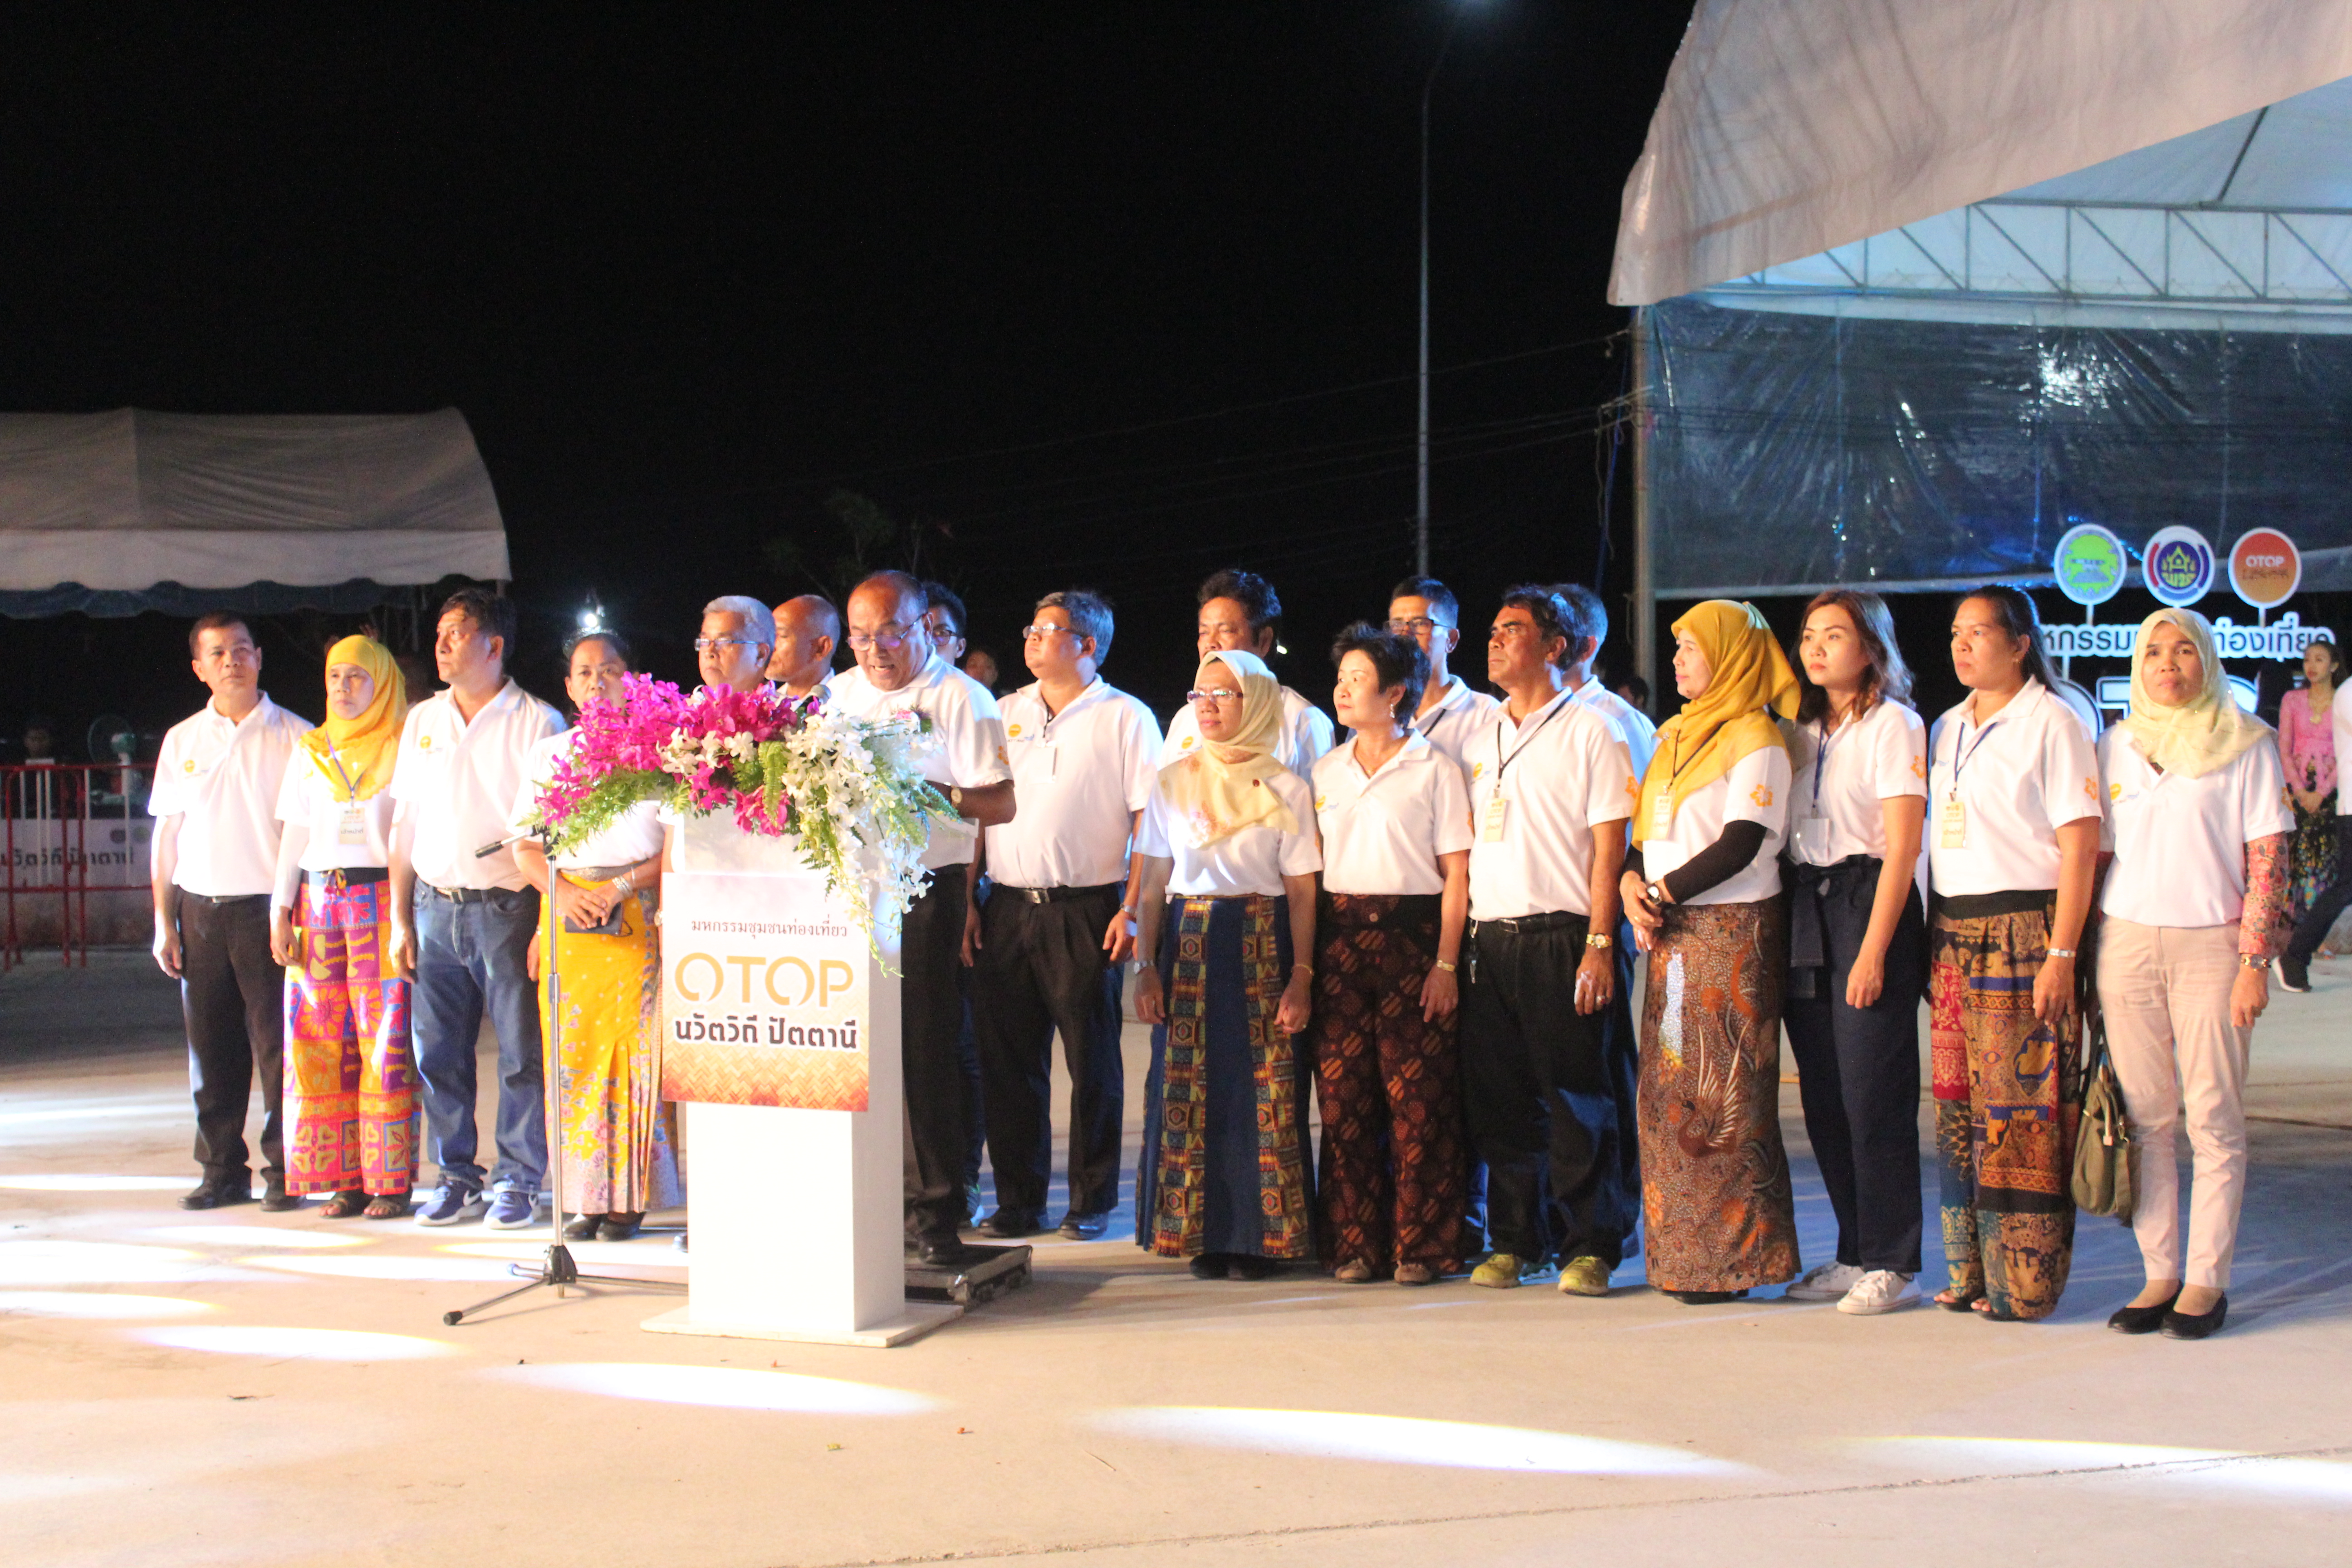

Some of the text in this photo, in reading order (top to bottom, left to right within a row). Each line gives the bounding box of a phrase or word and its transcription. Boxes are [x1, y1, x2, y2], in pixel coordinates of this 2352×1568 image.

[2245, 554, 2285, 568] OTOP
[691, 914, 848, 940] มหกรรมชุมชนท่องเที่ยว
[675, 952, 853, 1007] OTOP
[675, 1013, 857, 1049] นวัตวิถี ปัตตานี
